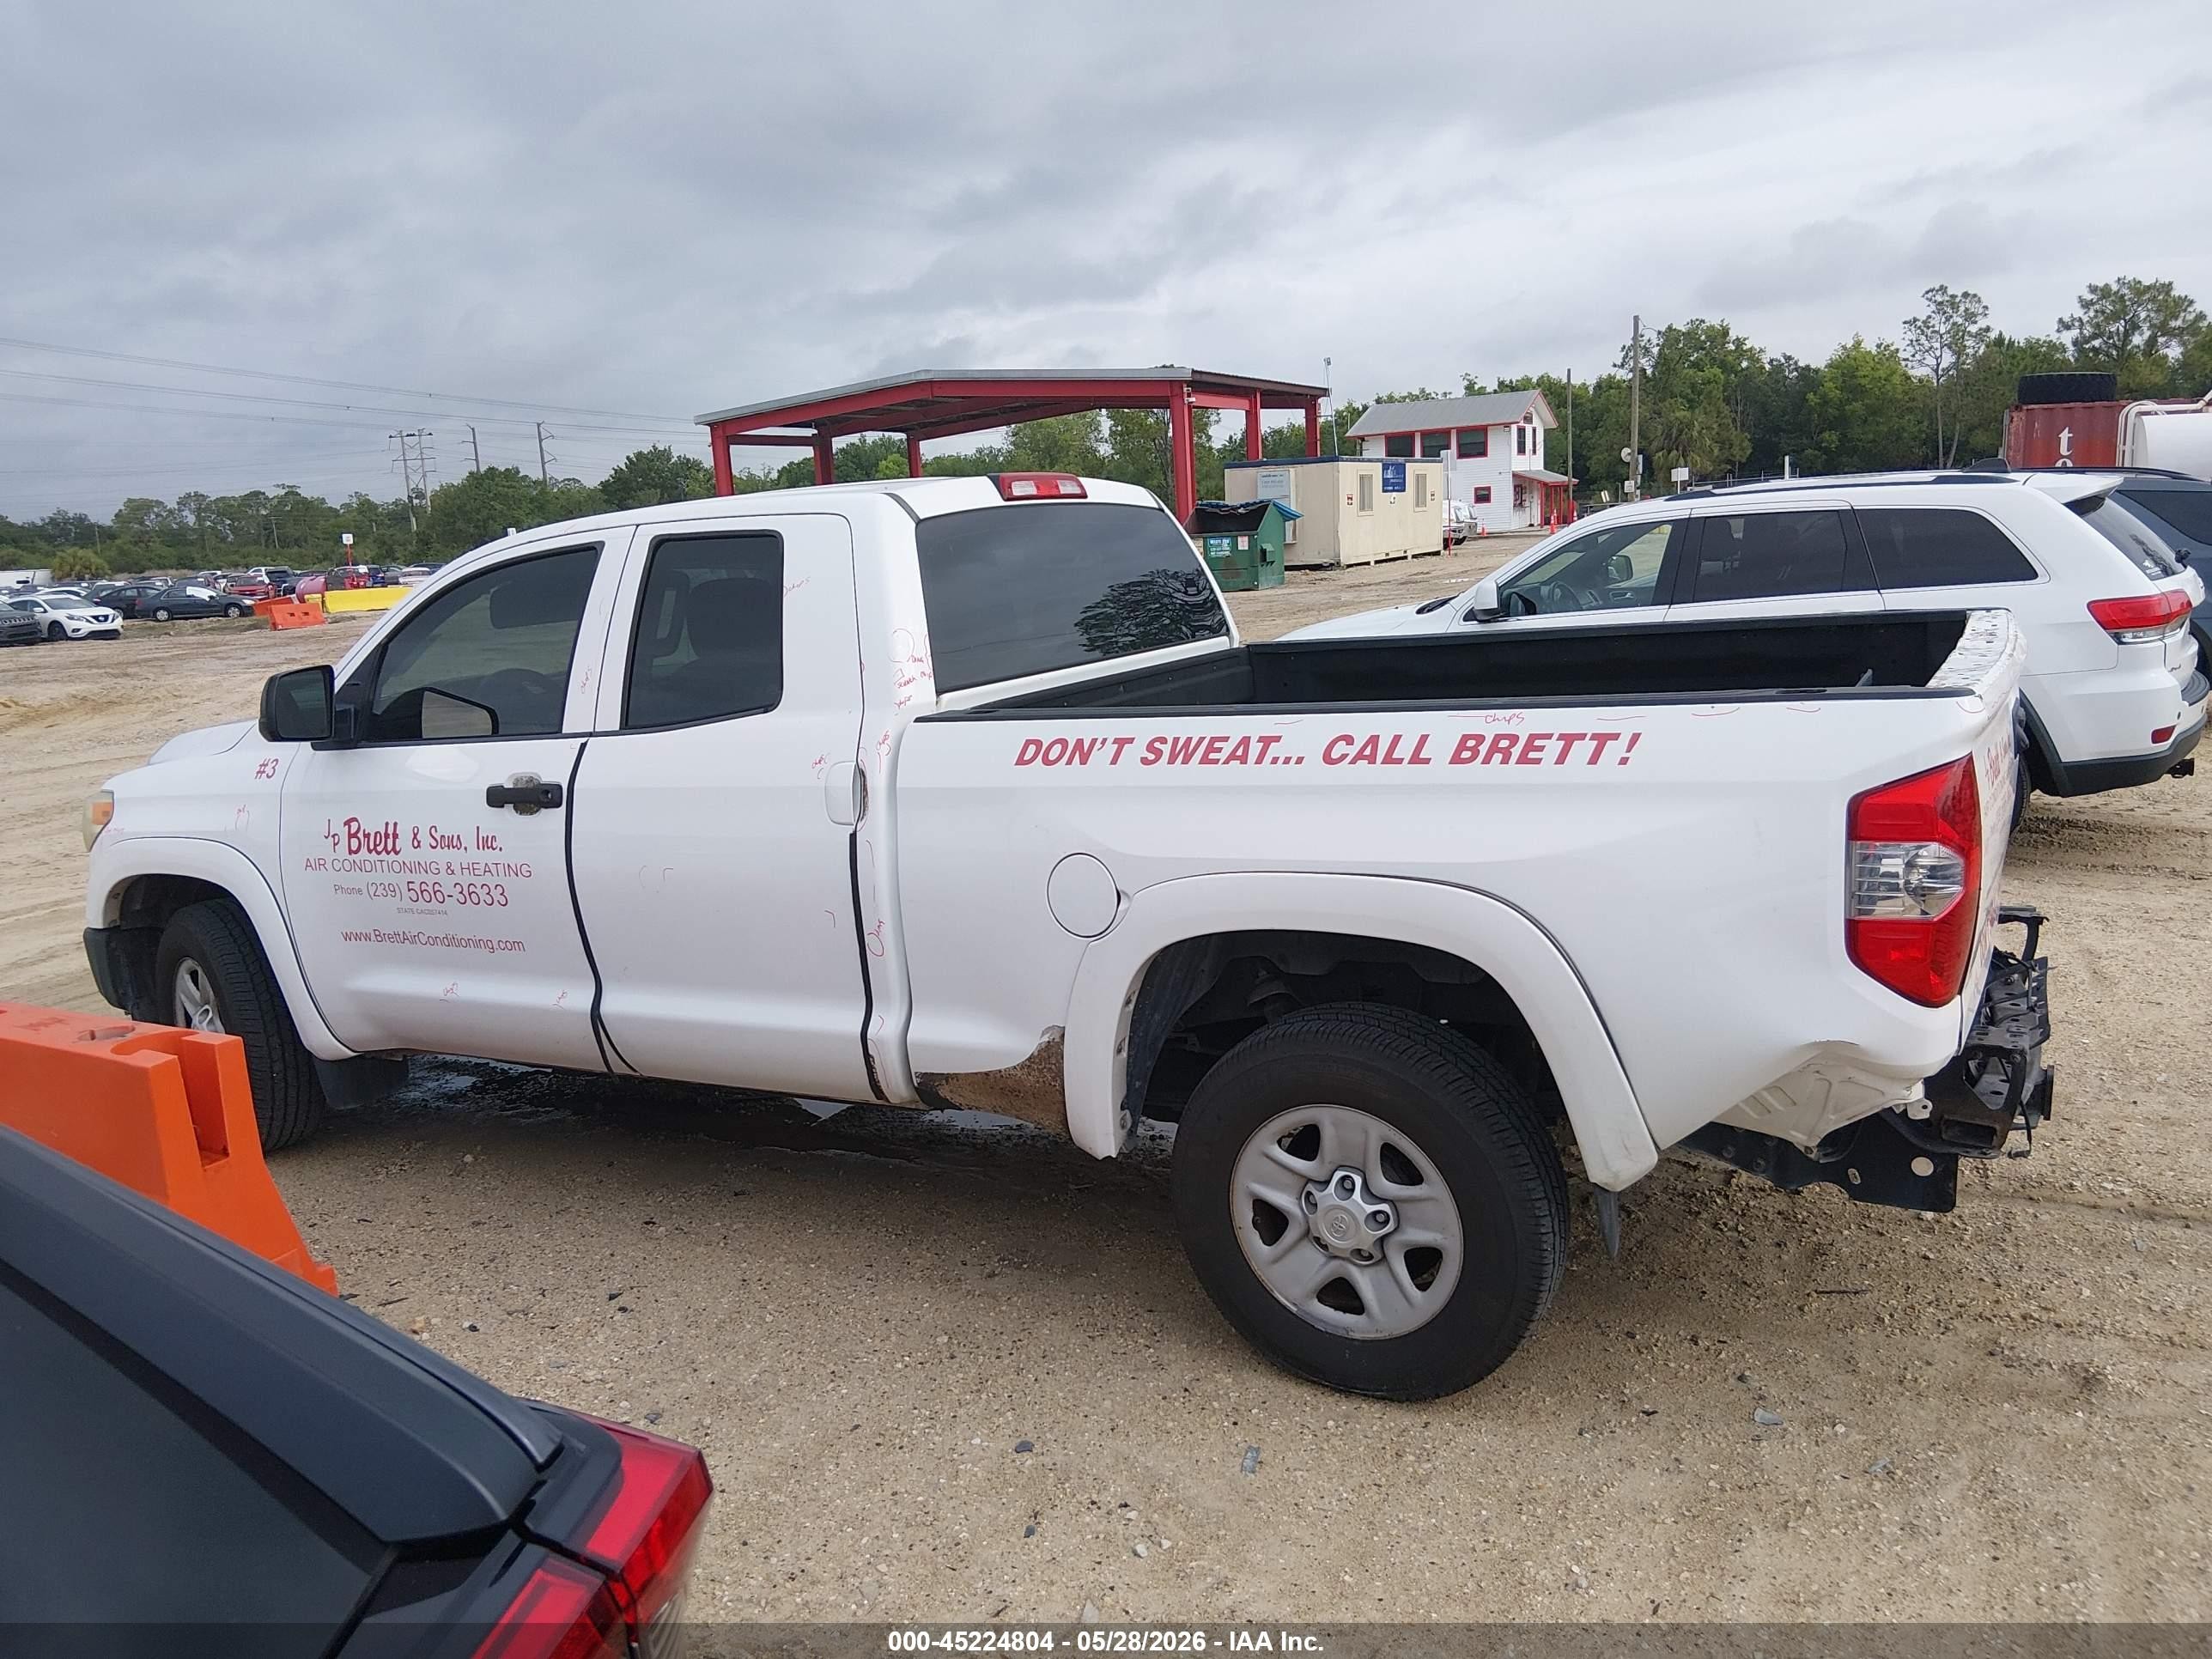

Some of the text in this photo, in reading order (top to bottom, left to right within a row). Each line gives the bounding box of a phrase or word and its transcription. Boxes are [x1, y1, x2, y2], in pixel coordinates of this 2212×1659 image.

[1015, 732, 1641, 766] DON'T SWEAT... CALL BRETT!
[254, 758, 279, 780] #3
[343, 817, 402, 855] Brett
[412, 825, 422, 849] &
[429, 825, 469, 854] Sons,
[476, 826, 503, 852] Inc.
[305, 858, 532, 878] AIR CONDITIONING & HEATING
[334, 881, 509, 907] Phone (239) 566-3633
[341, 928, 526, 953] www.BrettAirConditioning.com
